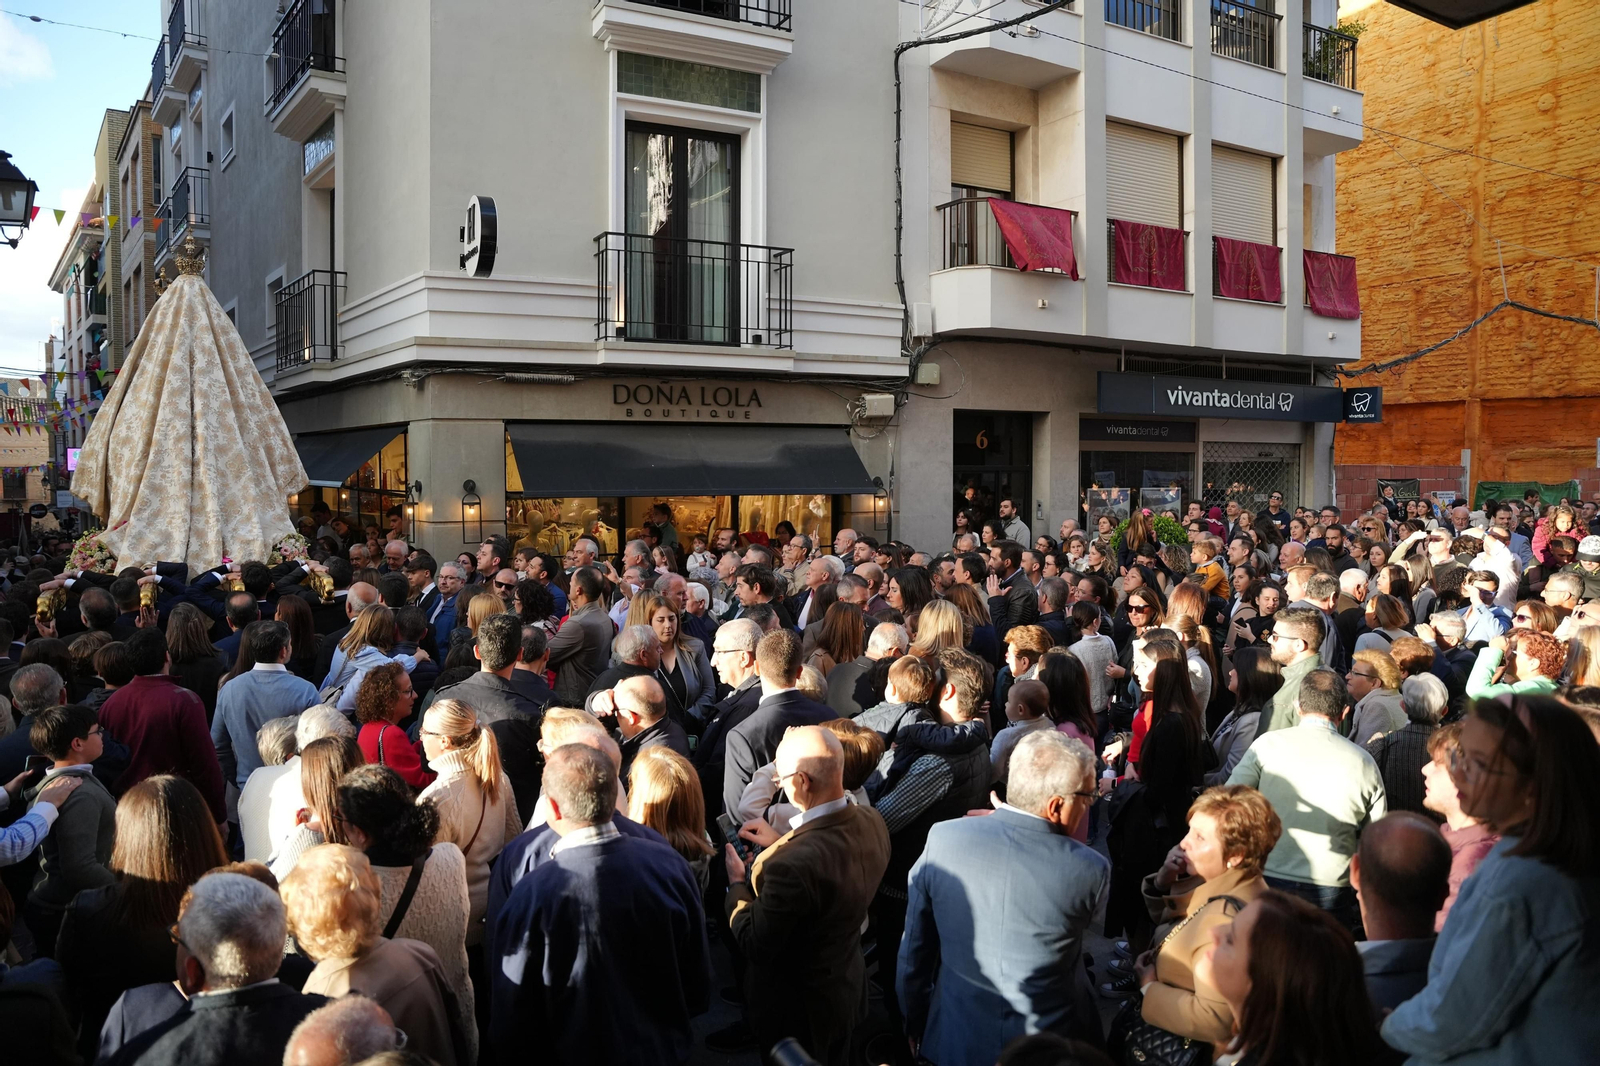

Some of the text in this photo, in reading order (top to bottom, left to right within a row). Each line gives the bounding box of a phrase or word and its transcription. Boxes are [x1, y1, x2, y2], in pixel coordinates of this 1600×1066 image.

[612, 380, 762, 408] DOÑA LOLA
[1167, 385, 1275, 410] vivantadental
[626, 408, 751, 419] BOUTIQUE
[975, 429, 989, 449] 6
[1106, 424, 1160, 436] vivantadental
